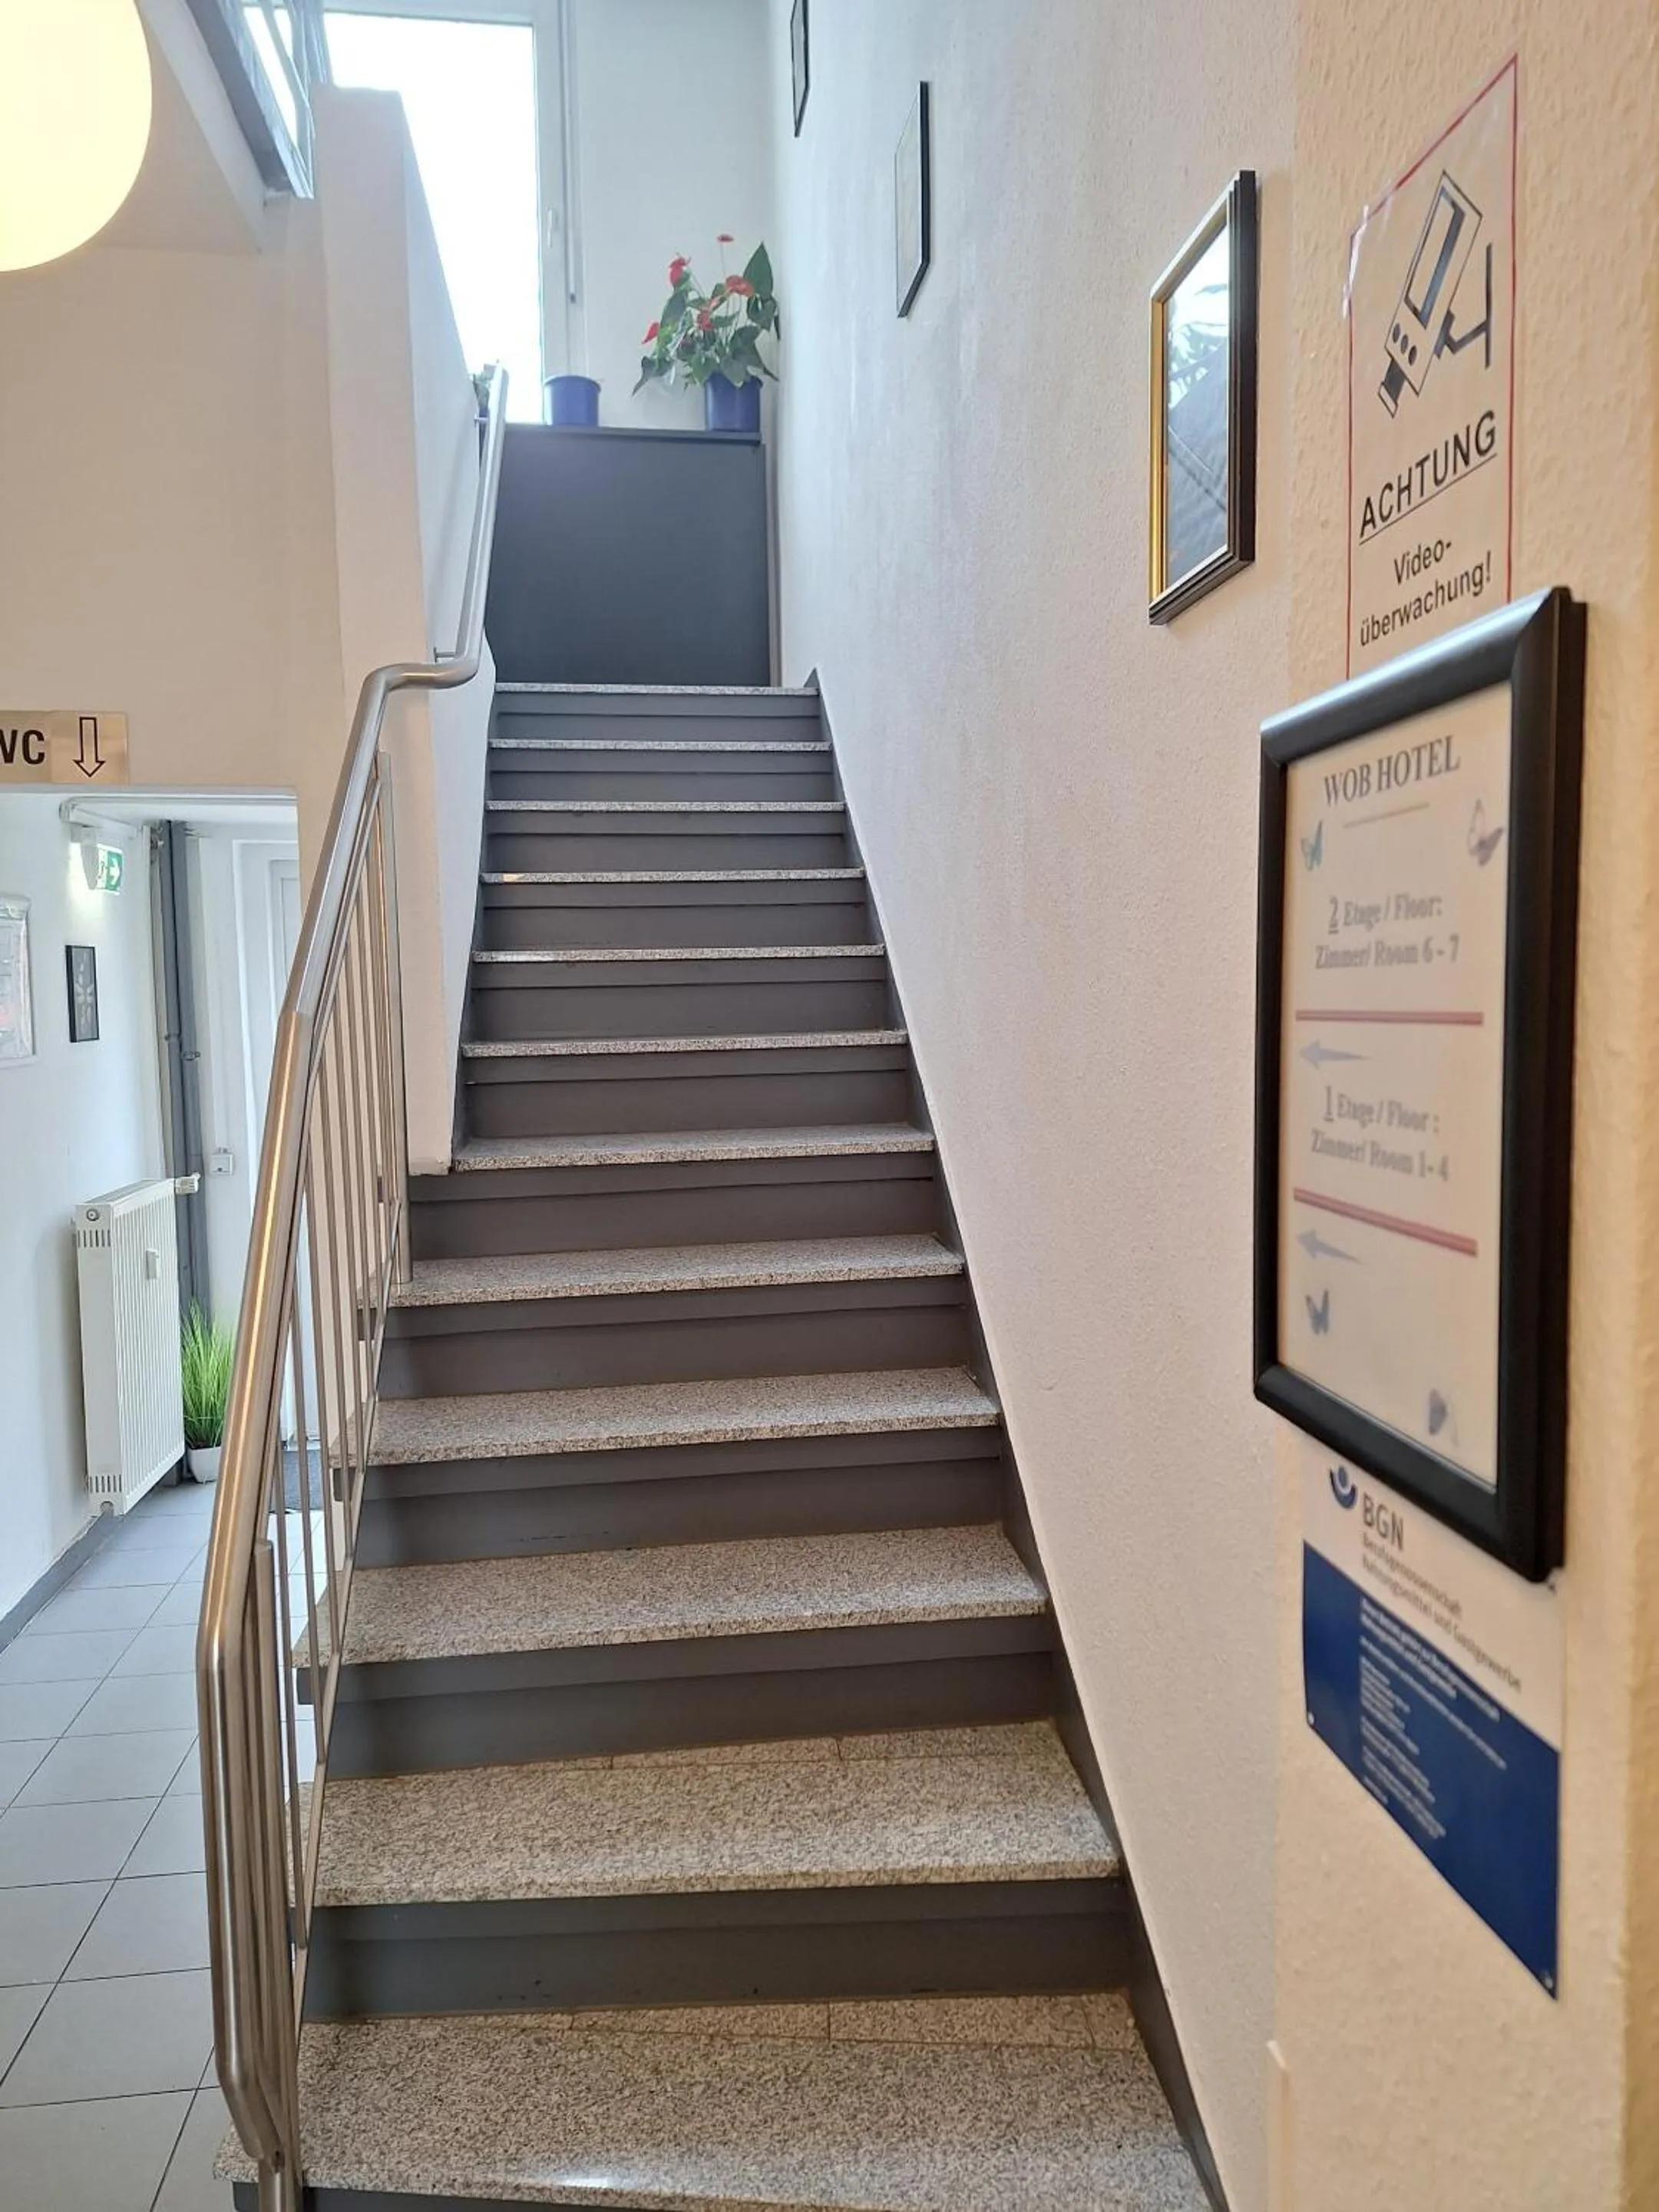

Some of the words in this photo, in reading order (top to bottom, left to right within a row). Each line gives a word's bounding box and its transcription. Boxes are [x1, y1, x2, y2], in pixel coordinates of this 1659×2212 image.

[1360, 409, 1496, 538] ACHTUNG
[1360, 550, 1492, 646] überwachung!
[1393, 539, 1452, 586] Video-
[1324, 763, 1371, 807] WOB
[1376, 736, 1461, 792] HOTEL
[1363, 1492, 1404, 1552] BGN
